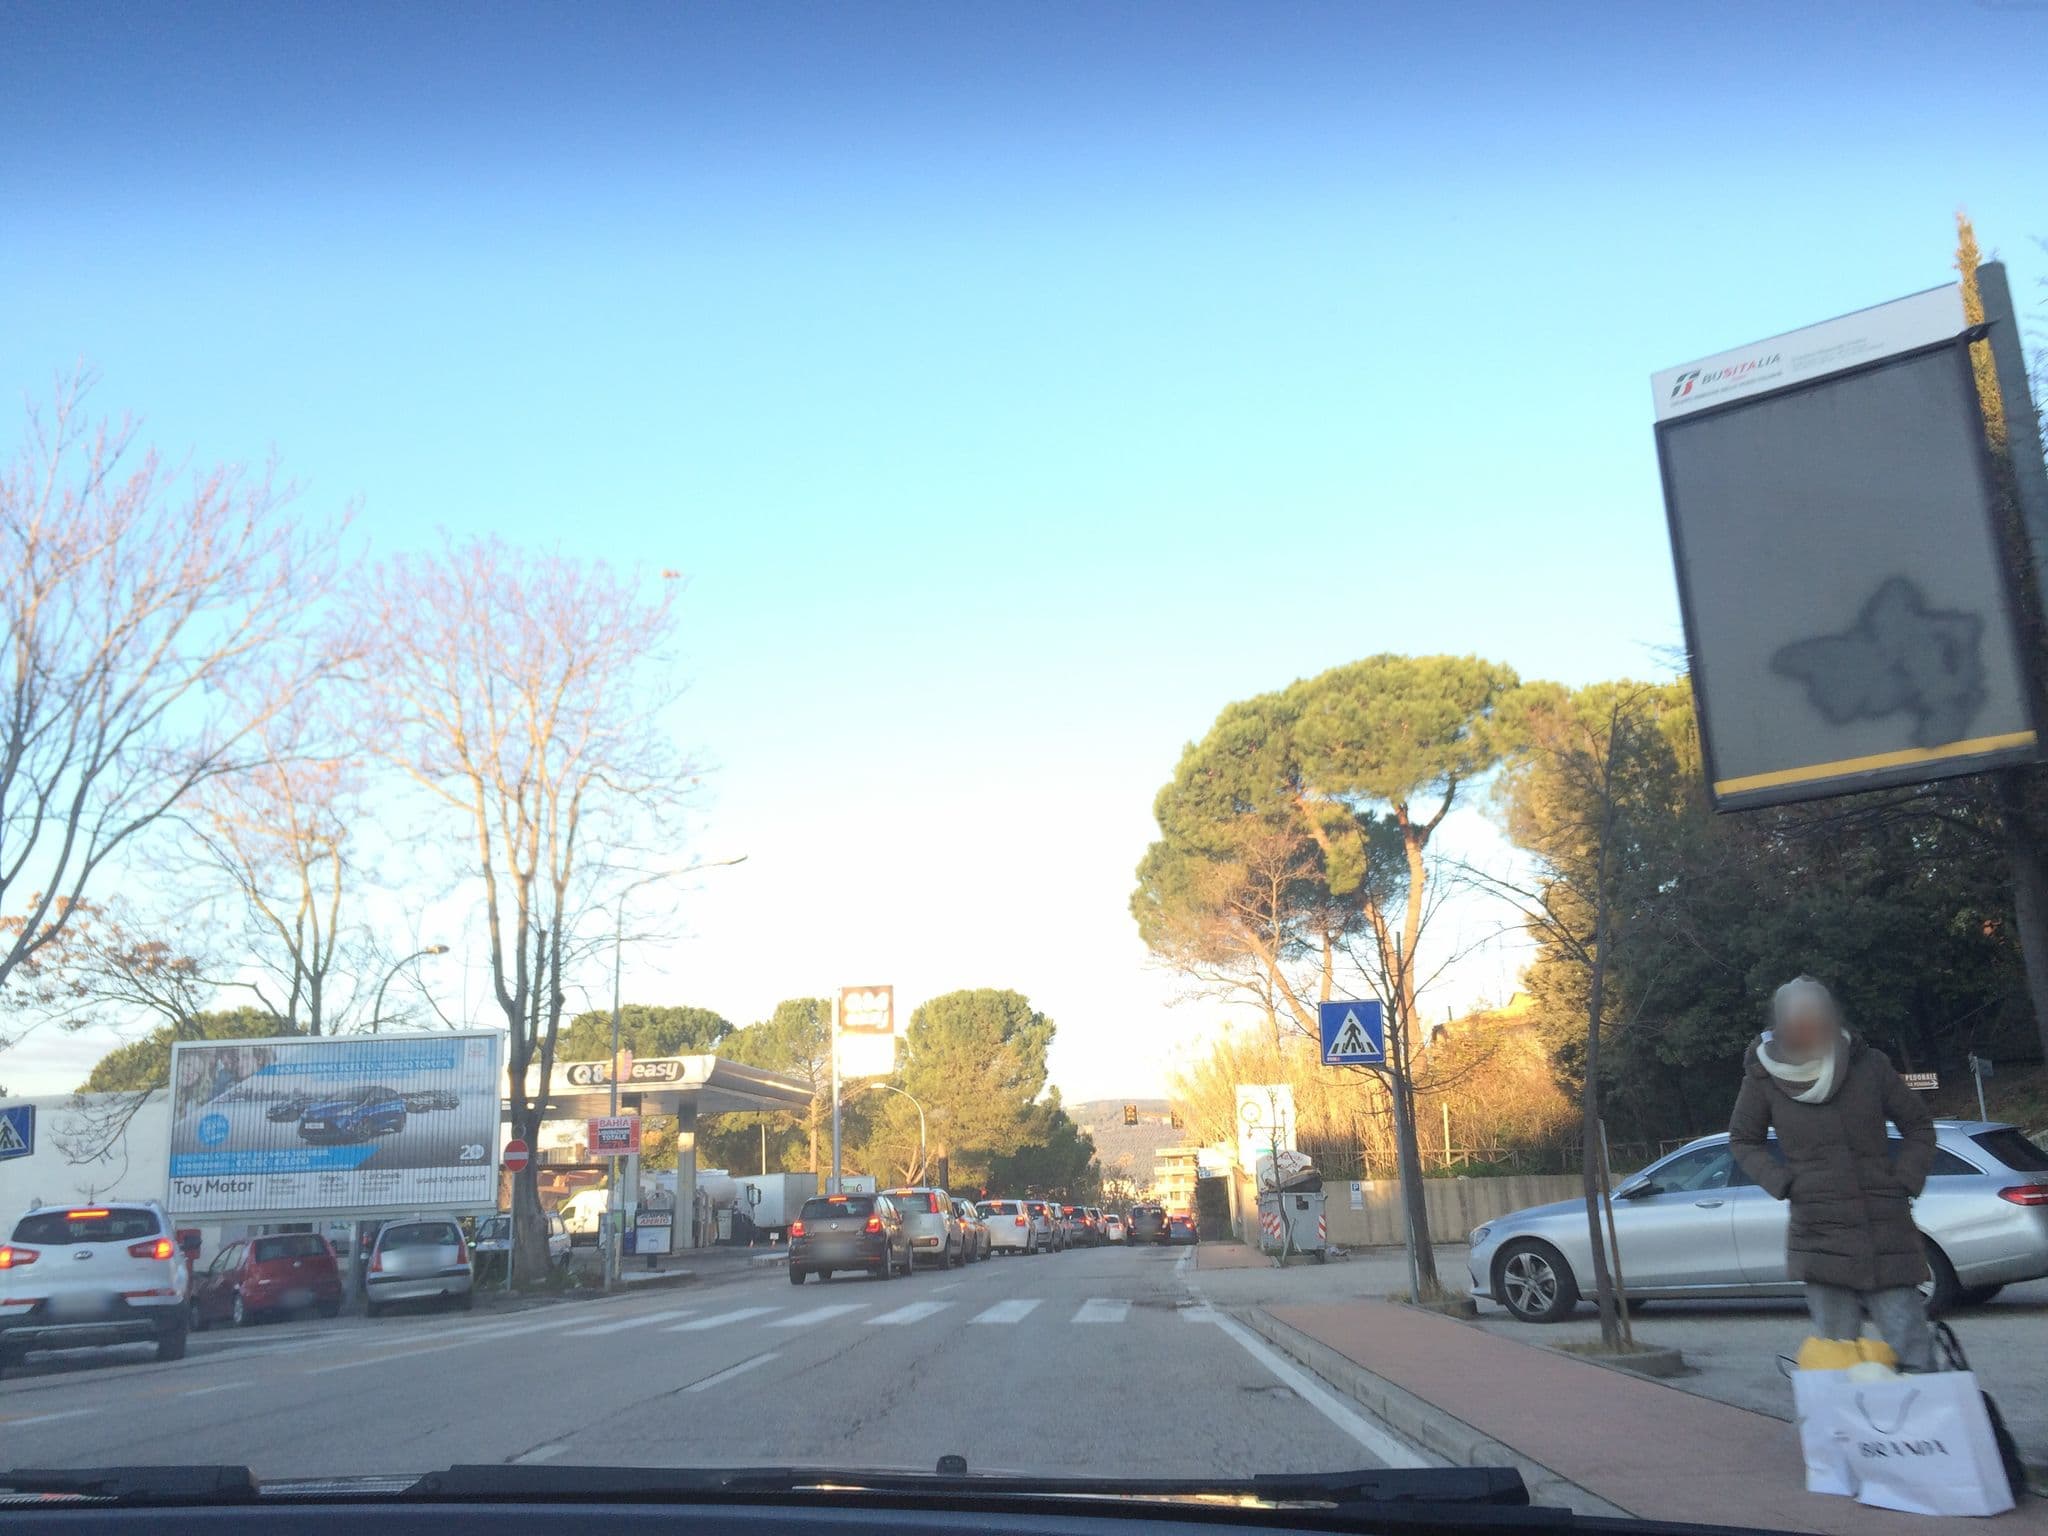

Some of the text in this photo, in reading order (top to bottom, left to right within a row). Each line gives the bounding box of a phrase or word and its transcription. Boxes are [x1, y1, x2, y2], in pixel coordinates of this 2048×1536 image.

[1702, 352, 1781, 385] BUSITALIA
[574, 1062, 678, 1084] Q8 easy
[460, 1144, 485, 1160] 20
[174, 1180, 203, 1198] Toy
[205, 1179, 254, 1193] Motor
